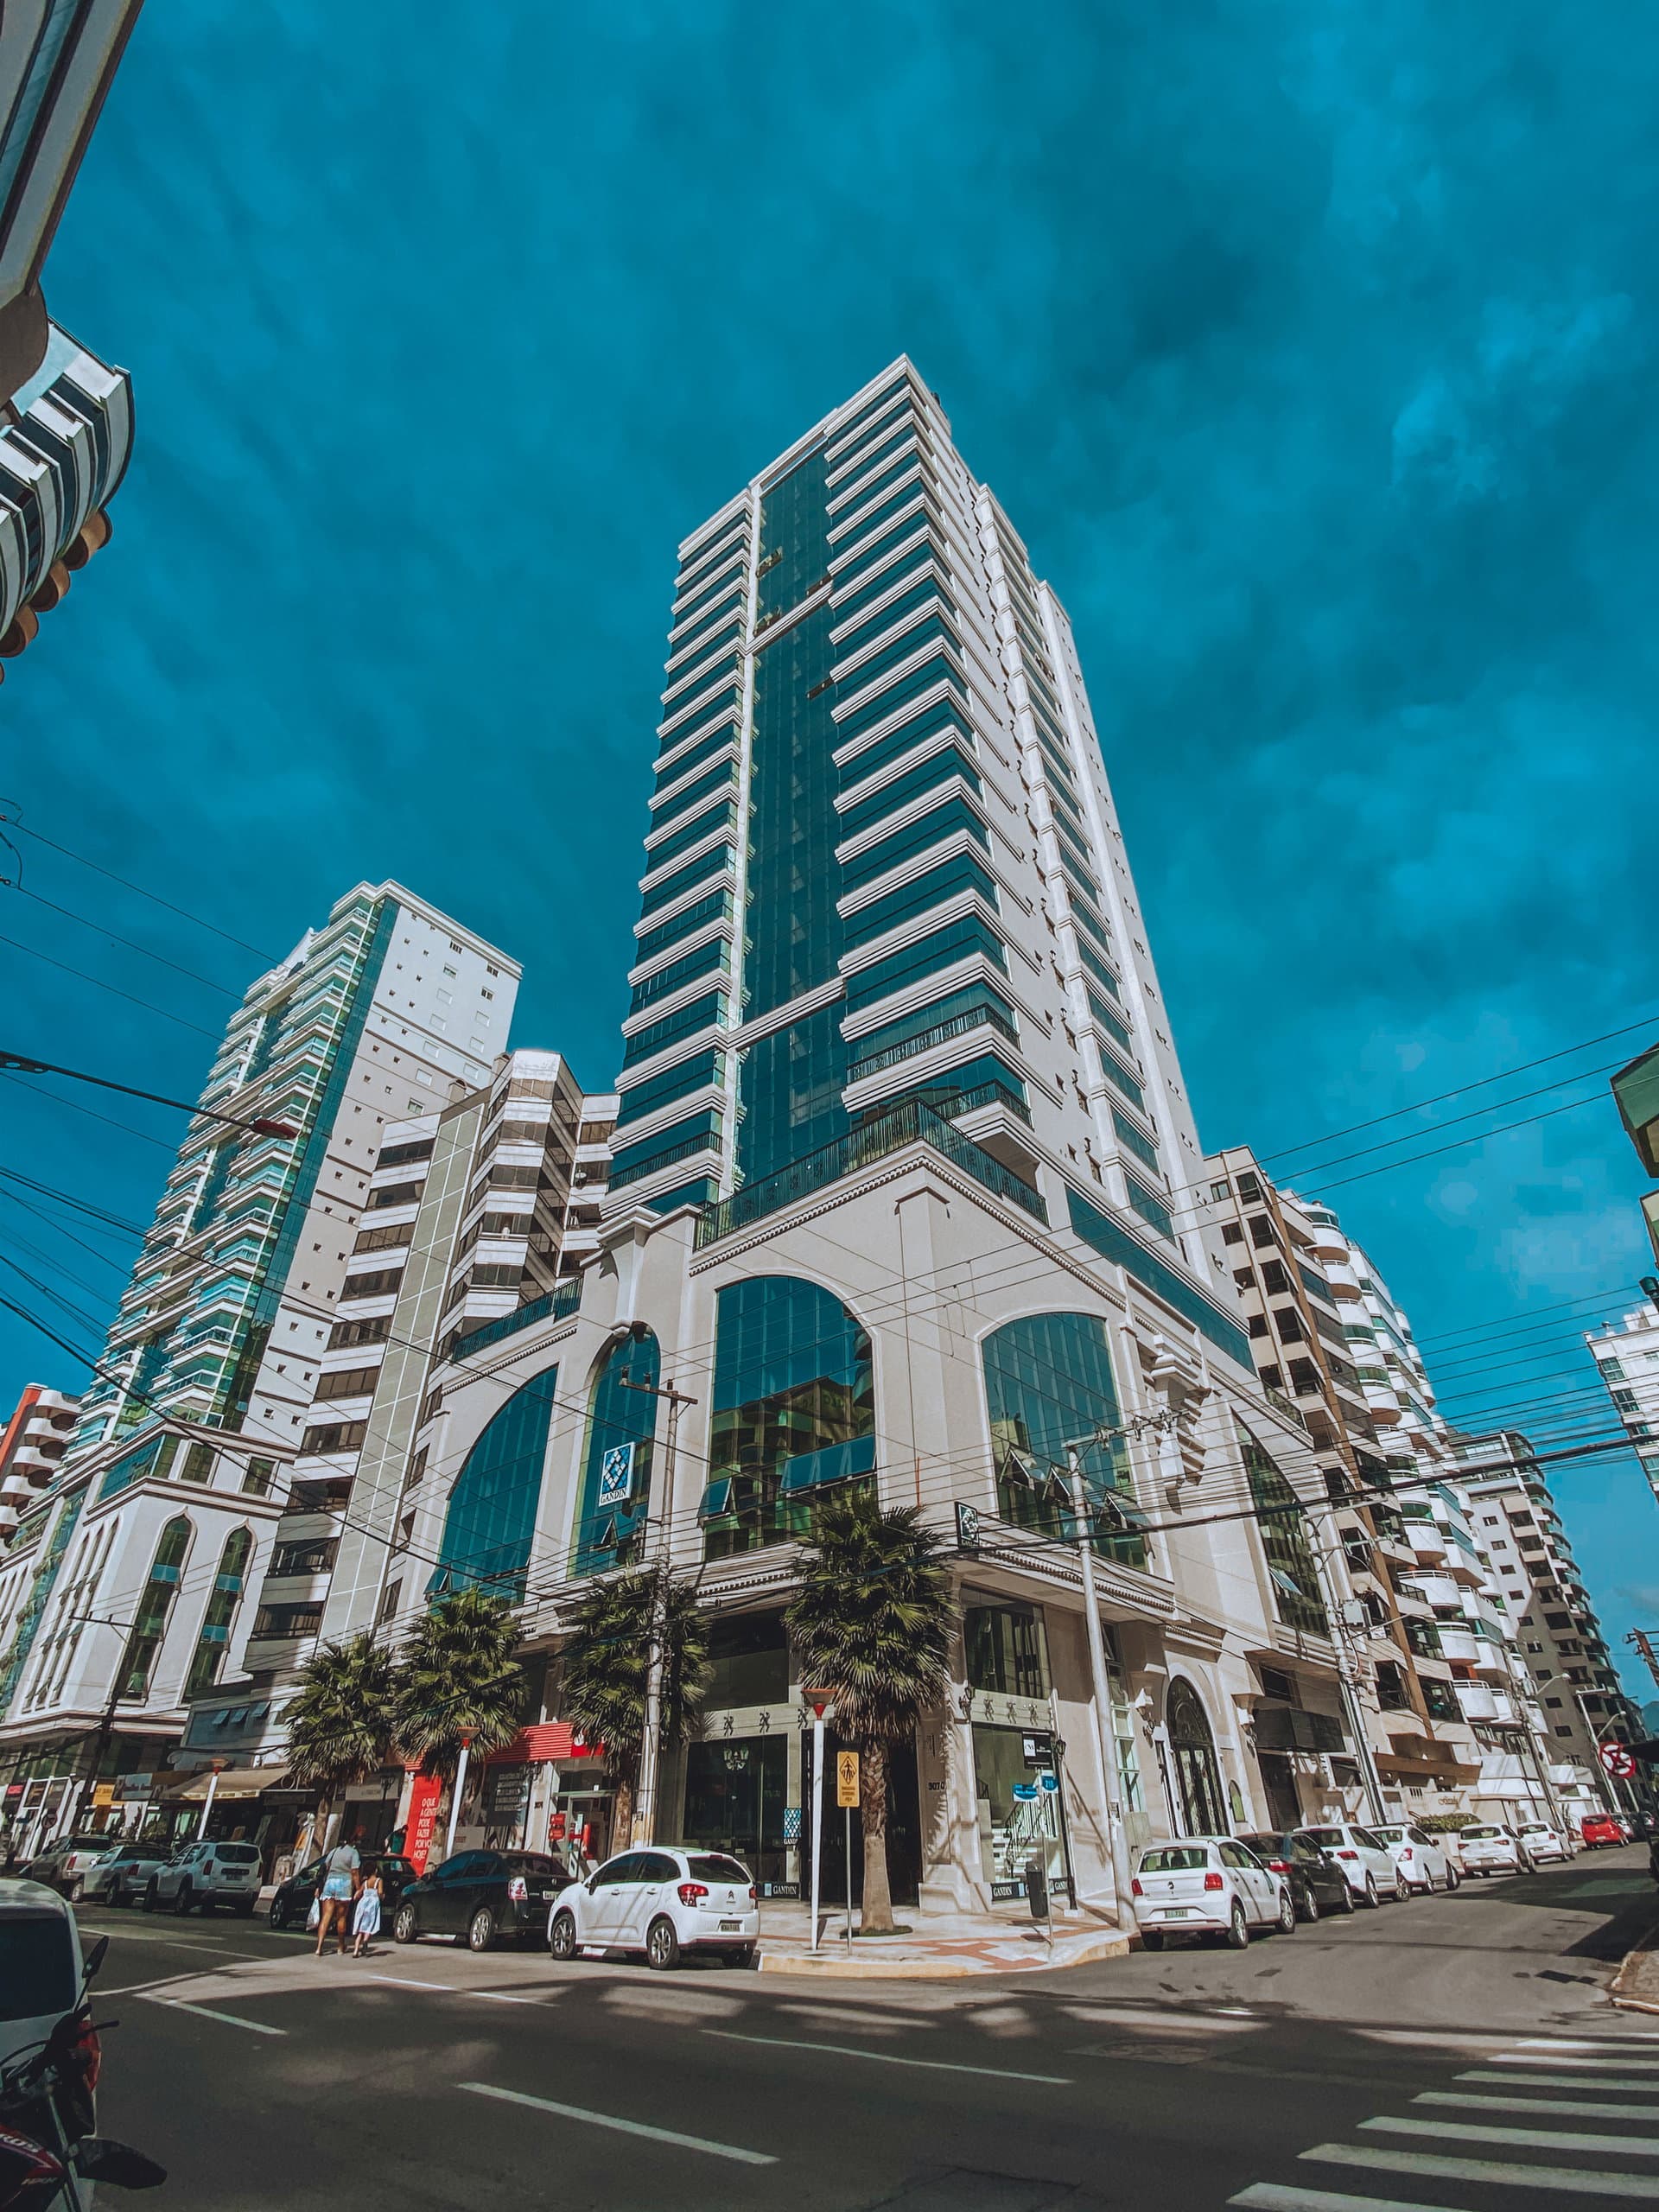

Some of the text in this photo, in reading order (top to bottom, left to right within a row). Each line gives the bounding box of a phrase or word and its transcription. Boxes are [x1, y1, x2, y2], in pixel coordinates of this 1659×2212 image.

[601, 1488, 627, 1503] GANDIN
[426, 1797, 435, 1808] QUE
[418, 1818, 431, 1827] PODE
[416, 1828, 429, 1837] FAZER
[415, 1839, 424, 1848] POR
[773, 1885, 797, 1895] GANDIN
